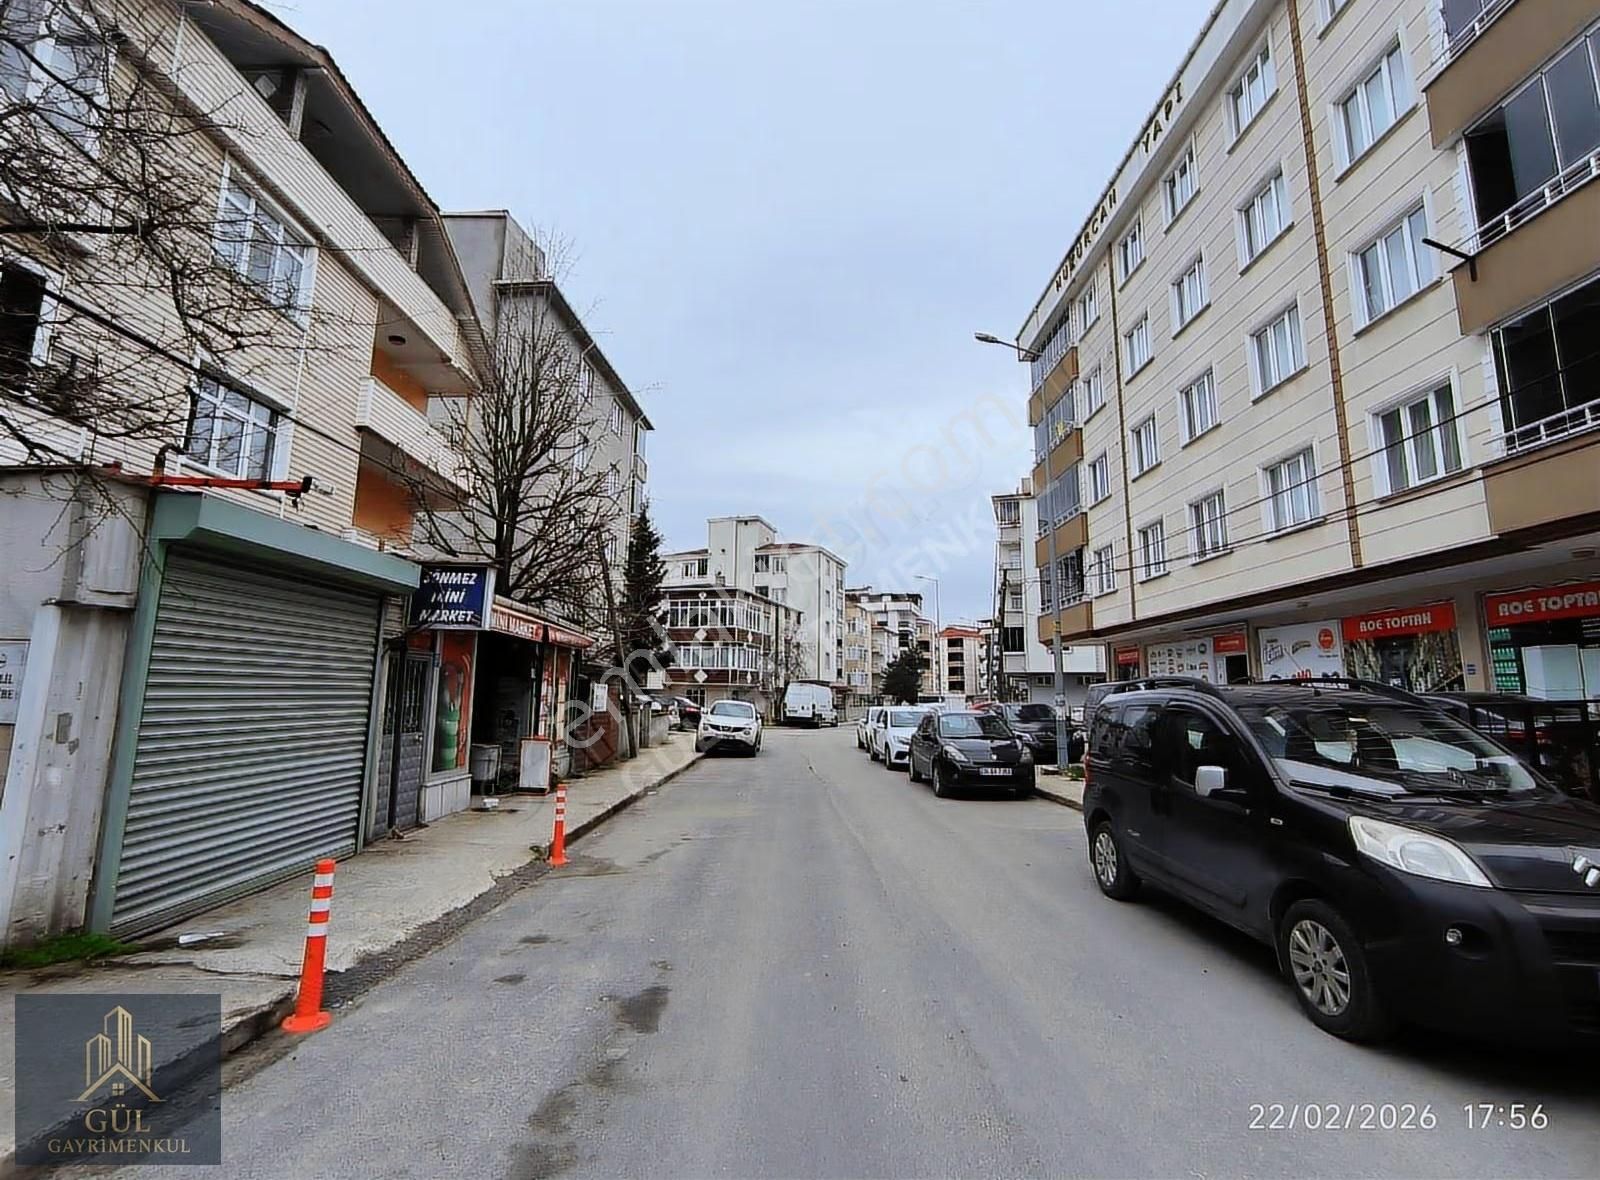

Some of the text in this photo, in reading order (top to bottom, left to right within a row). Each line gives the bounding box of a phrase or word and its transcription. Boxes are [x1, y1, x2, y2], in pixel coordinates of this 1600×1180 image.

[1141, 81, 1184, 154] YAPI
[1537, 590, 1600, 612] TOPTA
[1384, 611, 1433, 629] TOPTAN
